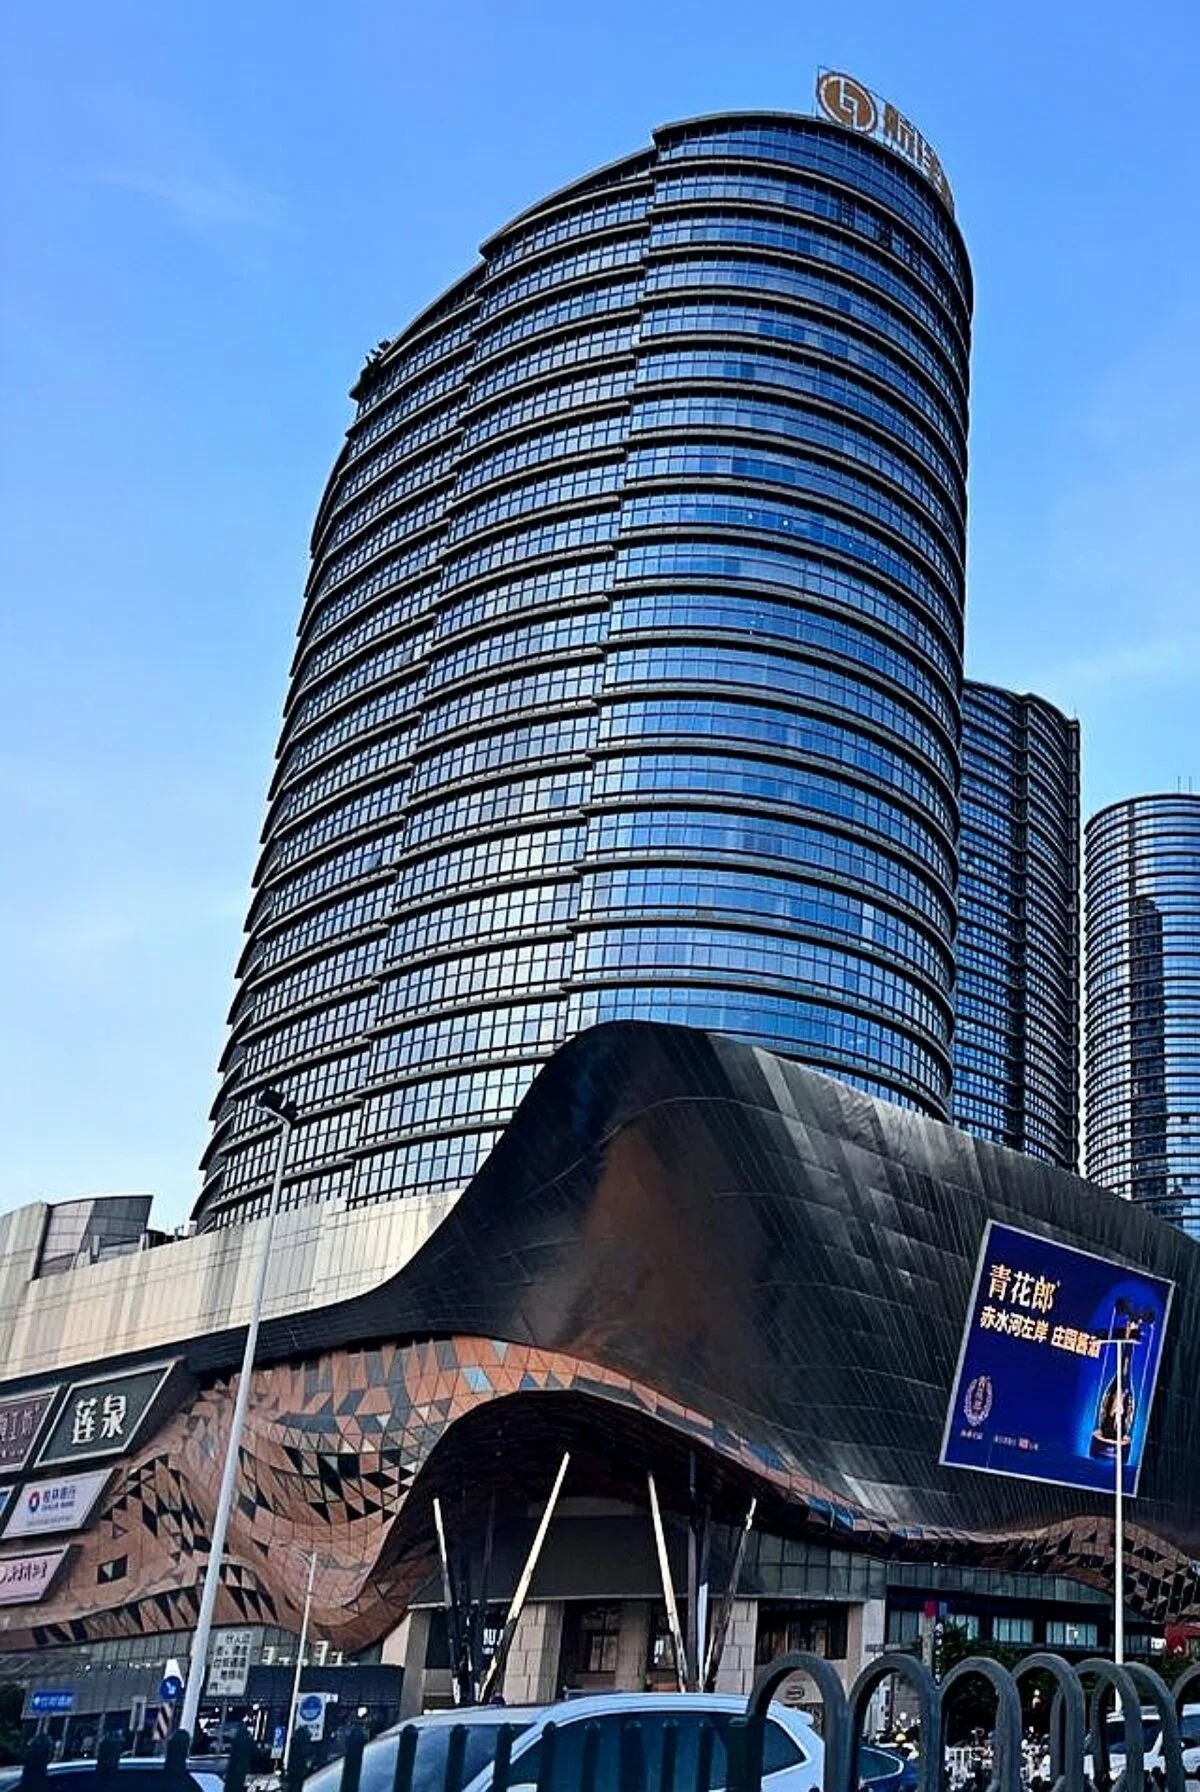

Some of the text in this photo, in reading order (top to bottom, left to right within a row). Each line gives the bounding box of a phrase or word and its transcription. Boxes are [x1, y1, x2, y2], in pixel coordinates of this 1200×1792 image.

[988, 1263, 1057, 1314] 青花郎
[979, 1305, 1049, 1343] 赤水河左岸
